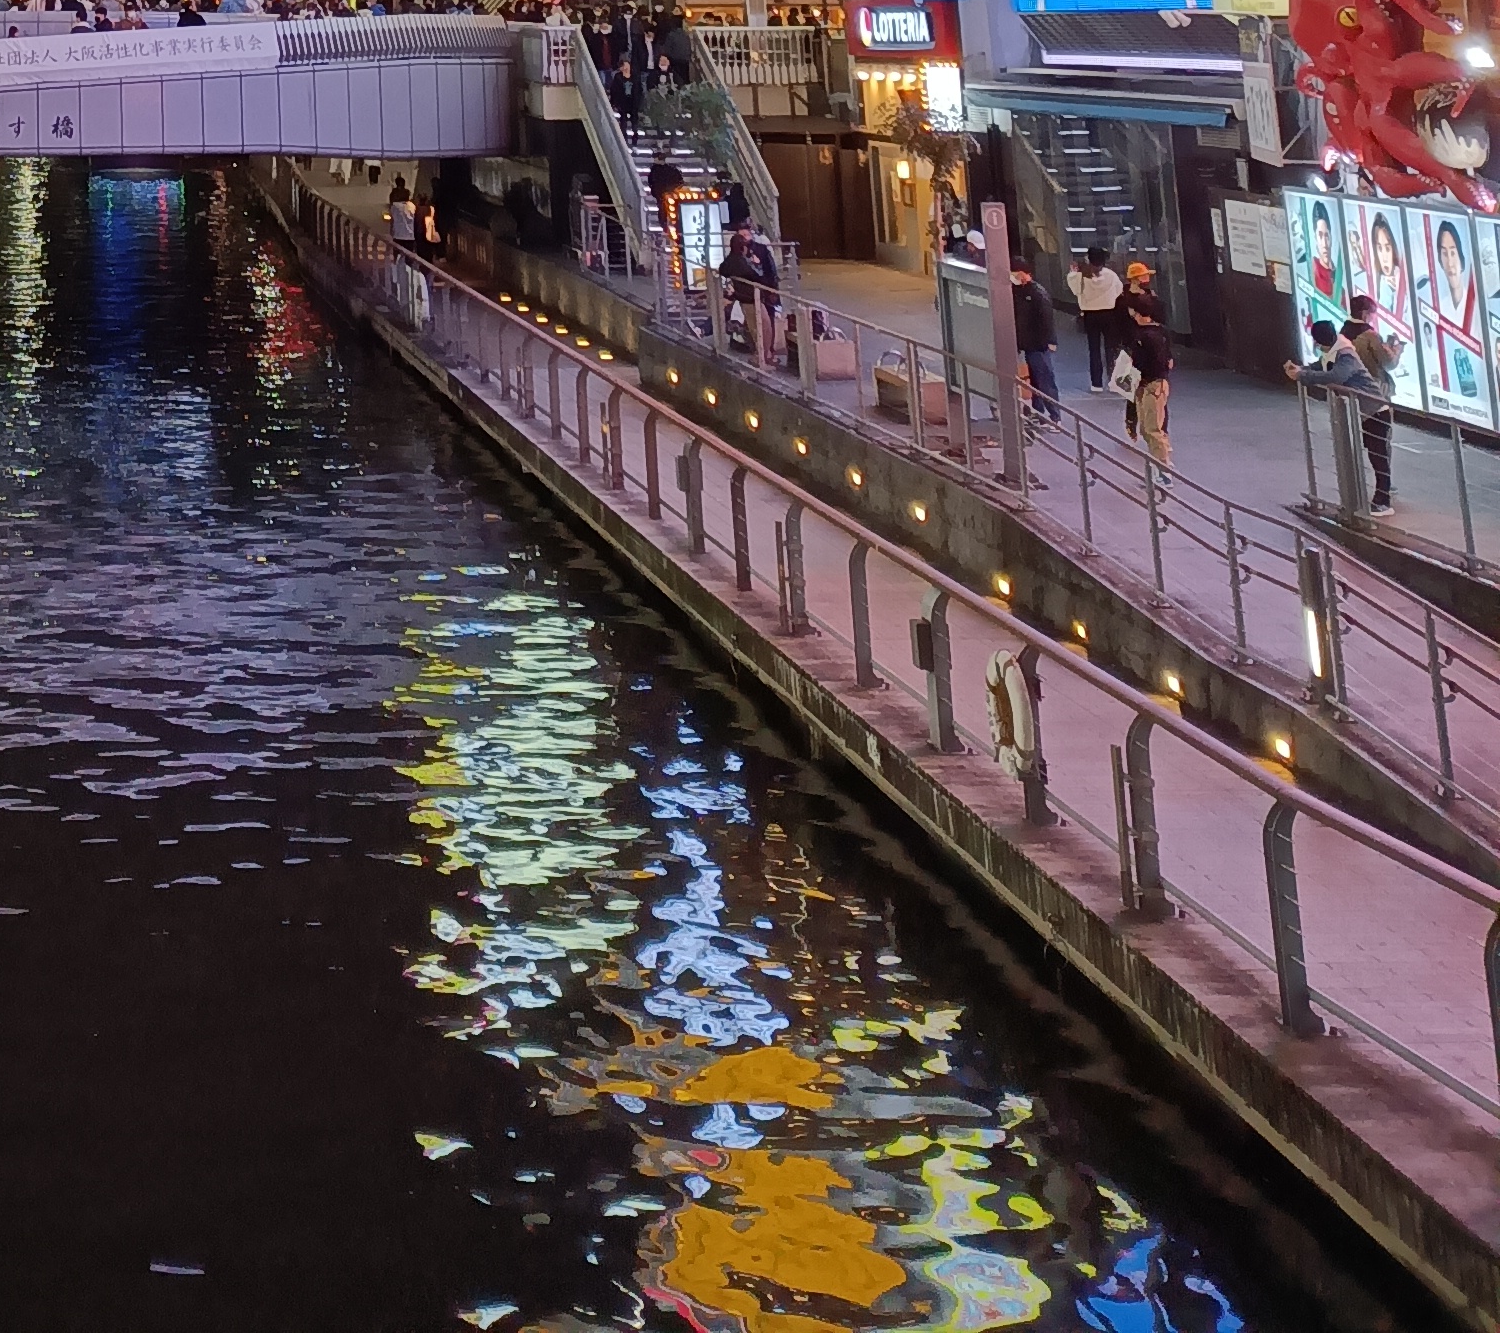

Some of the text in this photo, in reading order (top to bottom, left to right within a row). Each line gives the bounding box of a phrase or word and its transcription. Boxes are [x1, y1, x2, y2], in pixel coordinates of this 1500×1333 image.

[871, 11, 931, 42] LOTTERIA
[65, 34, 264, 63] 大阪活性化事業実行委員会
